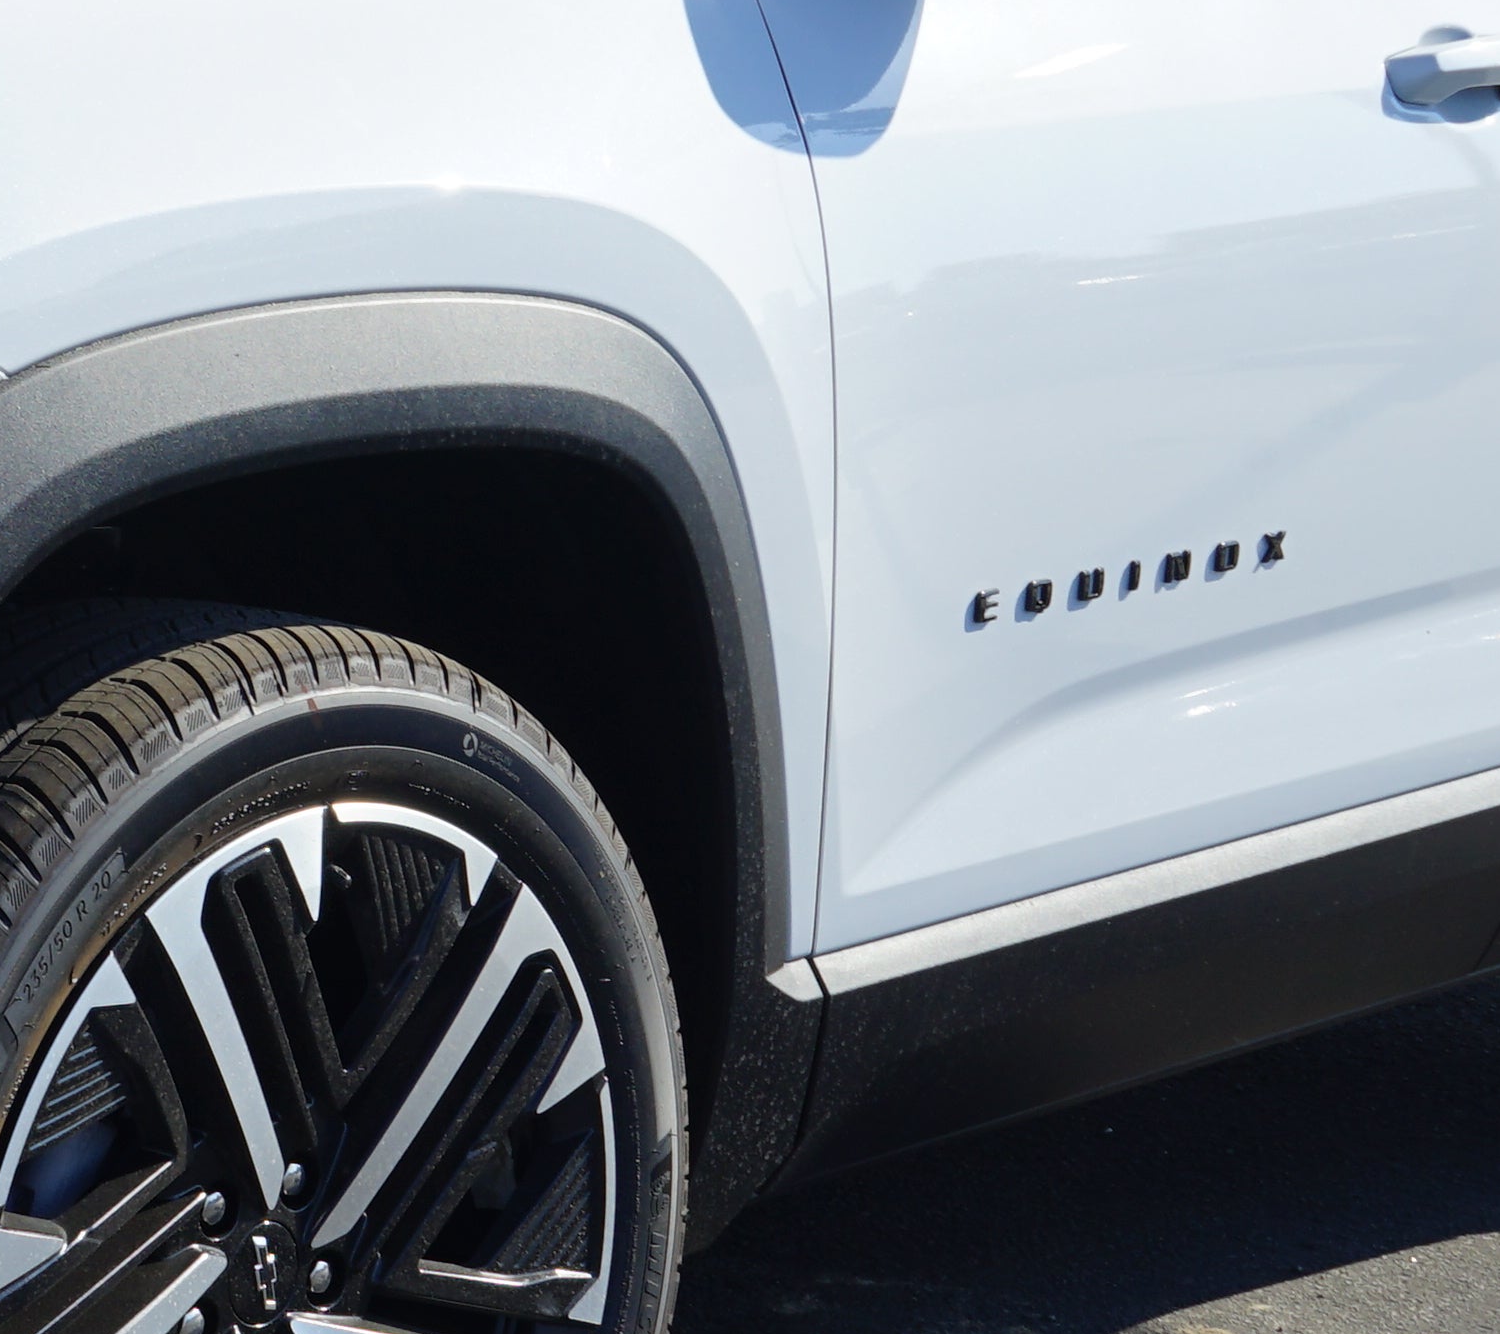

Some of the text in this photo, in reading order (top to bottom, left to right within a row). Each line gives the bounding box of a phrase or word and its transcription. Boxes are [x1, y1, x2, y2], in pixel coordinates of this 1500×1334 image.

[973, 530, 1286, 624] EQUINOX
[22, 869, 112, 1004] 235/50 R 20
